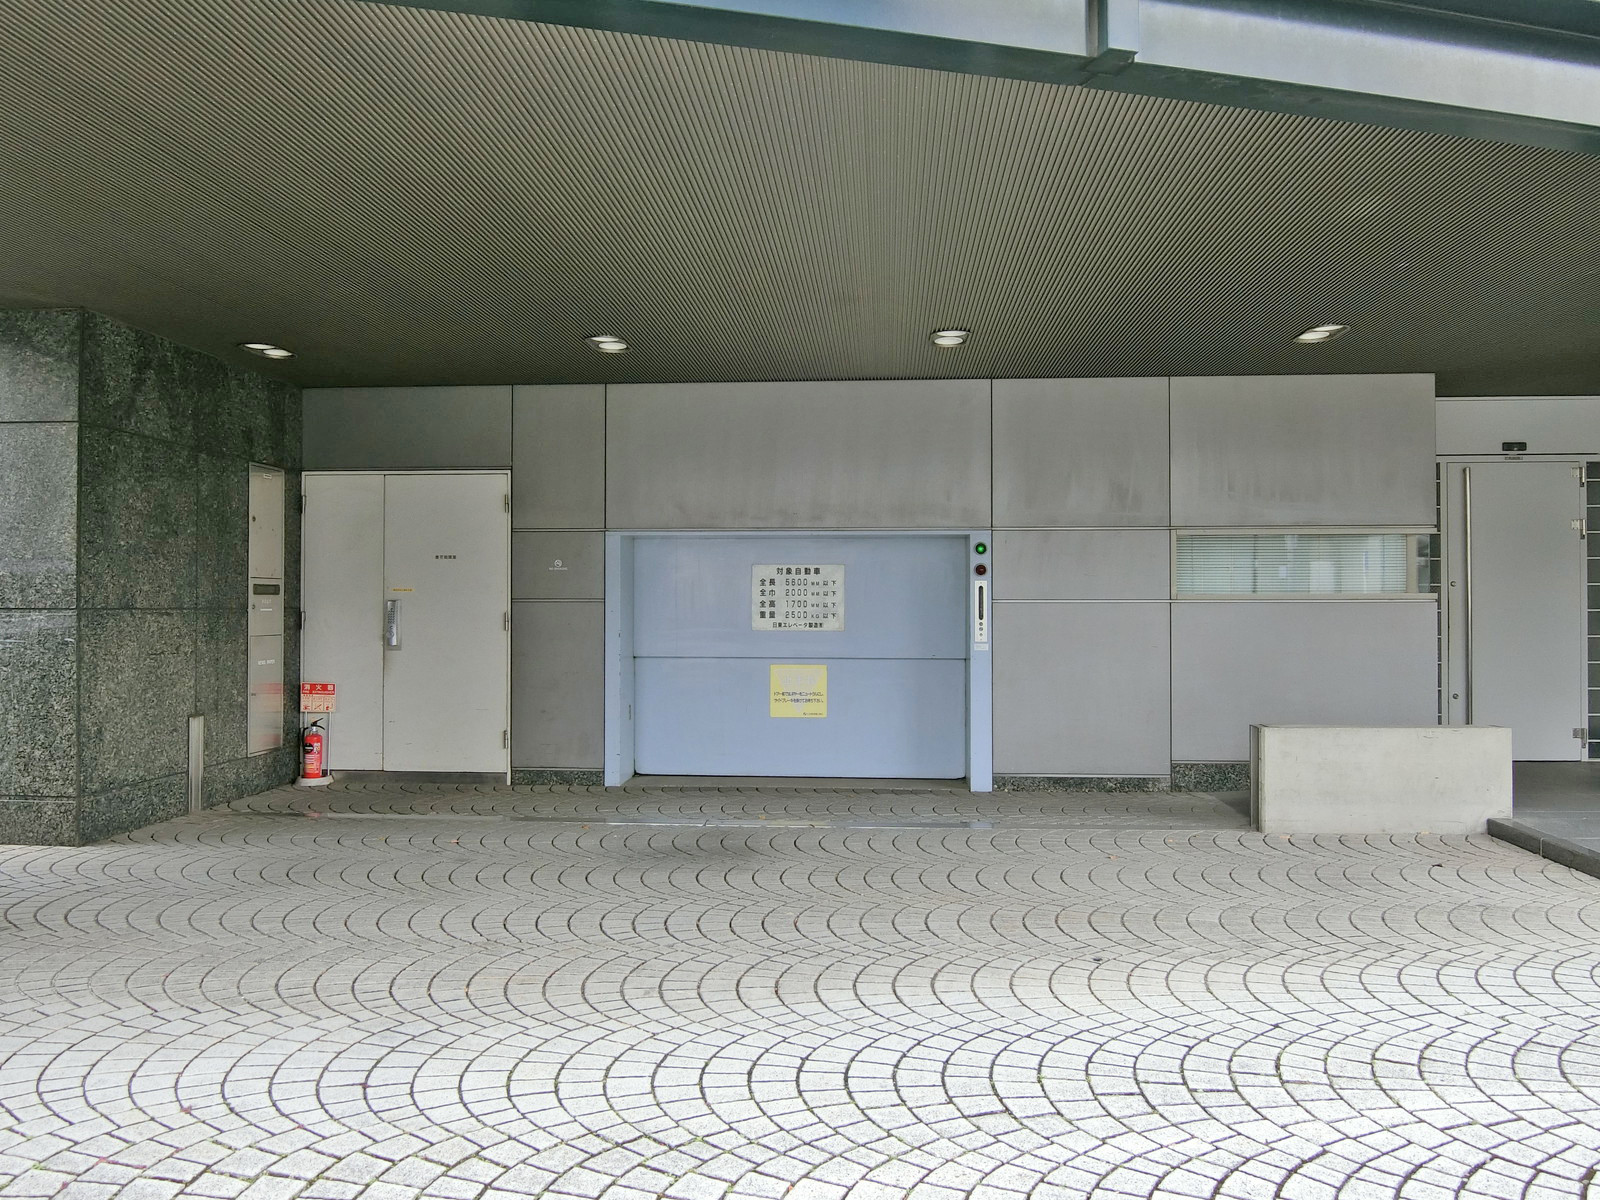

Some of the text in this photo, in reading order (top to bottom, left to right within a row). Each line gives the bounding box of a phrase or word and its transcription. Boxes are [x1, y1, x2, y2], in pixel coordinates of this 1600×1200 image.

[776, 567, 821, 575] 対象自動車
[759, 578, 776, 587] 全長
[785, 588, 808, 597] 2000
[759, 600, 776, 608] 全高
[785, 600, 808, 608] 1700
[759, 610, 776, 619] 重量
[785, 610, 808, 619] 2500
